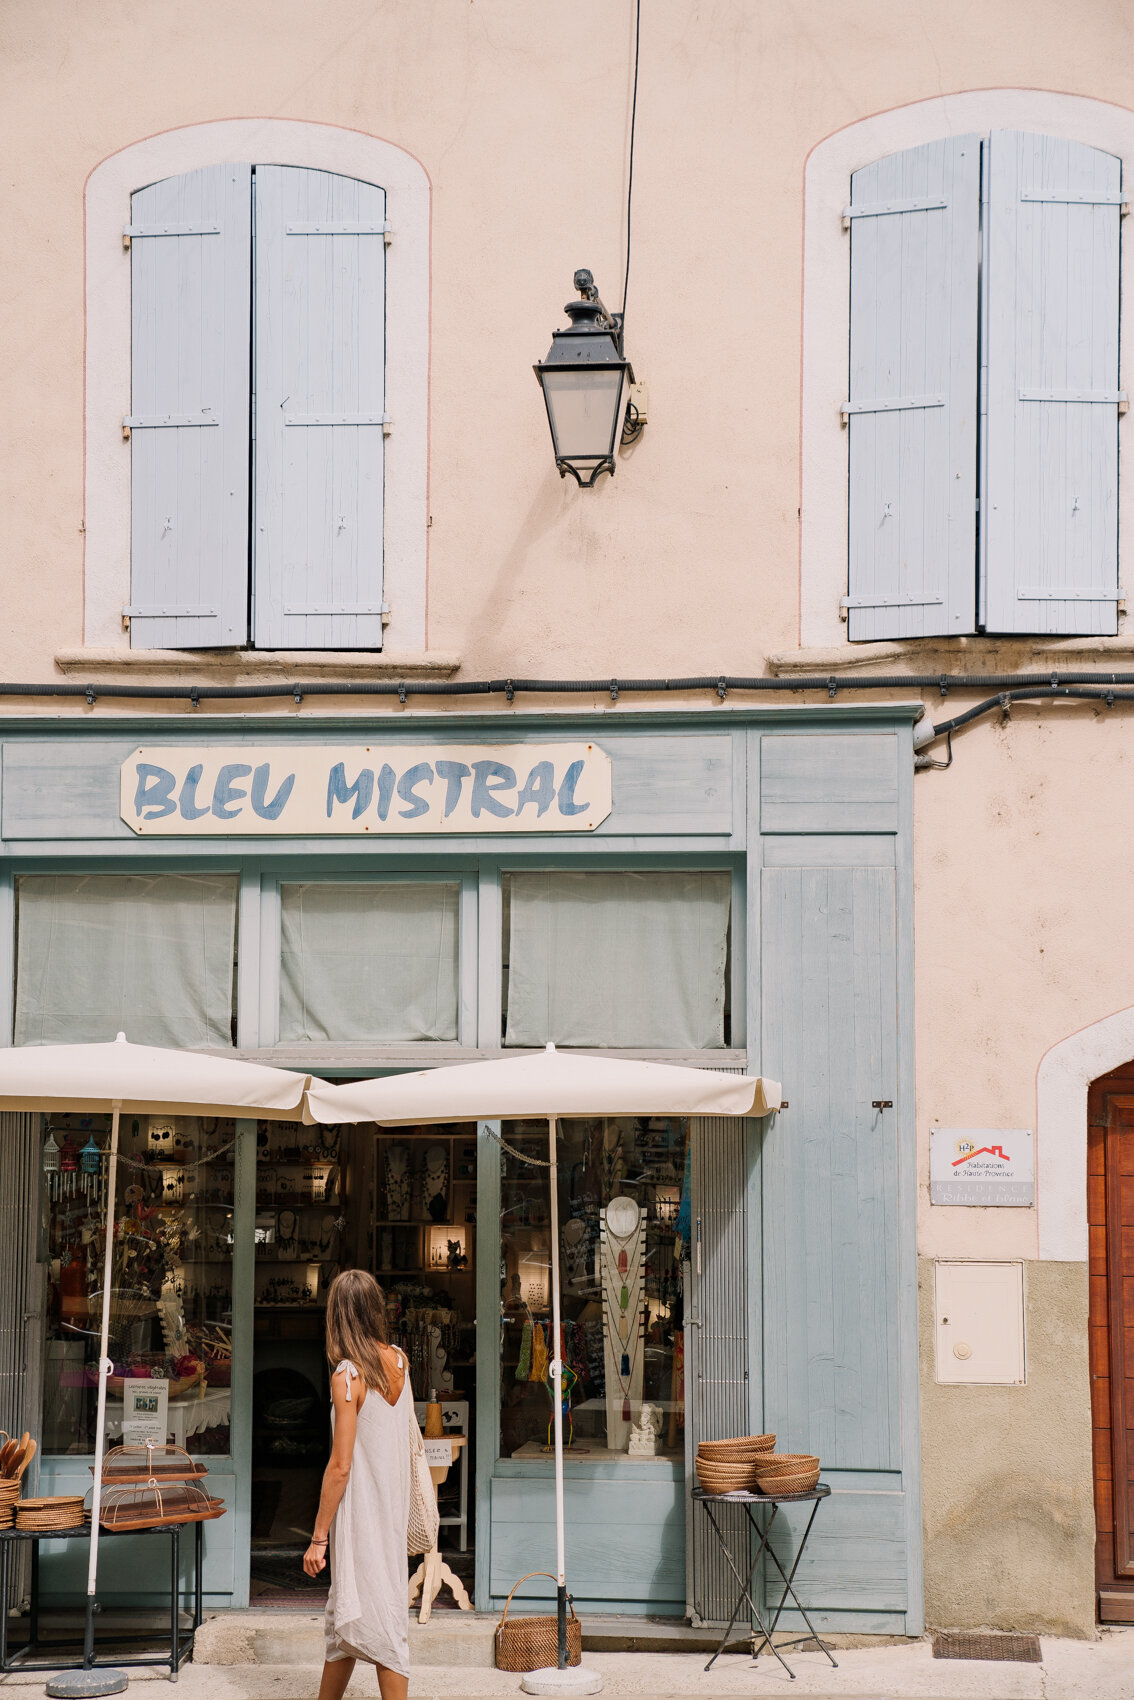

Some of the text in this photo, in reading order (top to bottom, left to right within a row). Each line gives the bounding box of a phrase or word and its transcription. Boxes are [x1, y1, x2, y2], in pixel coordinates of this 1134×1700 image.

[134, 759, 592, 821] BLEU MISTRAL
[967, 1161, 1005, 1169] Habitations
